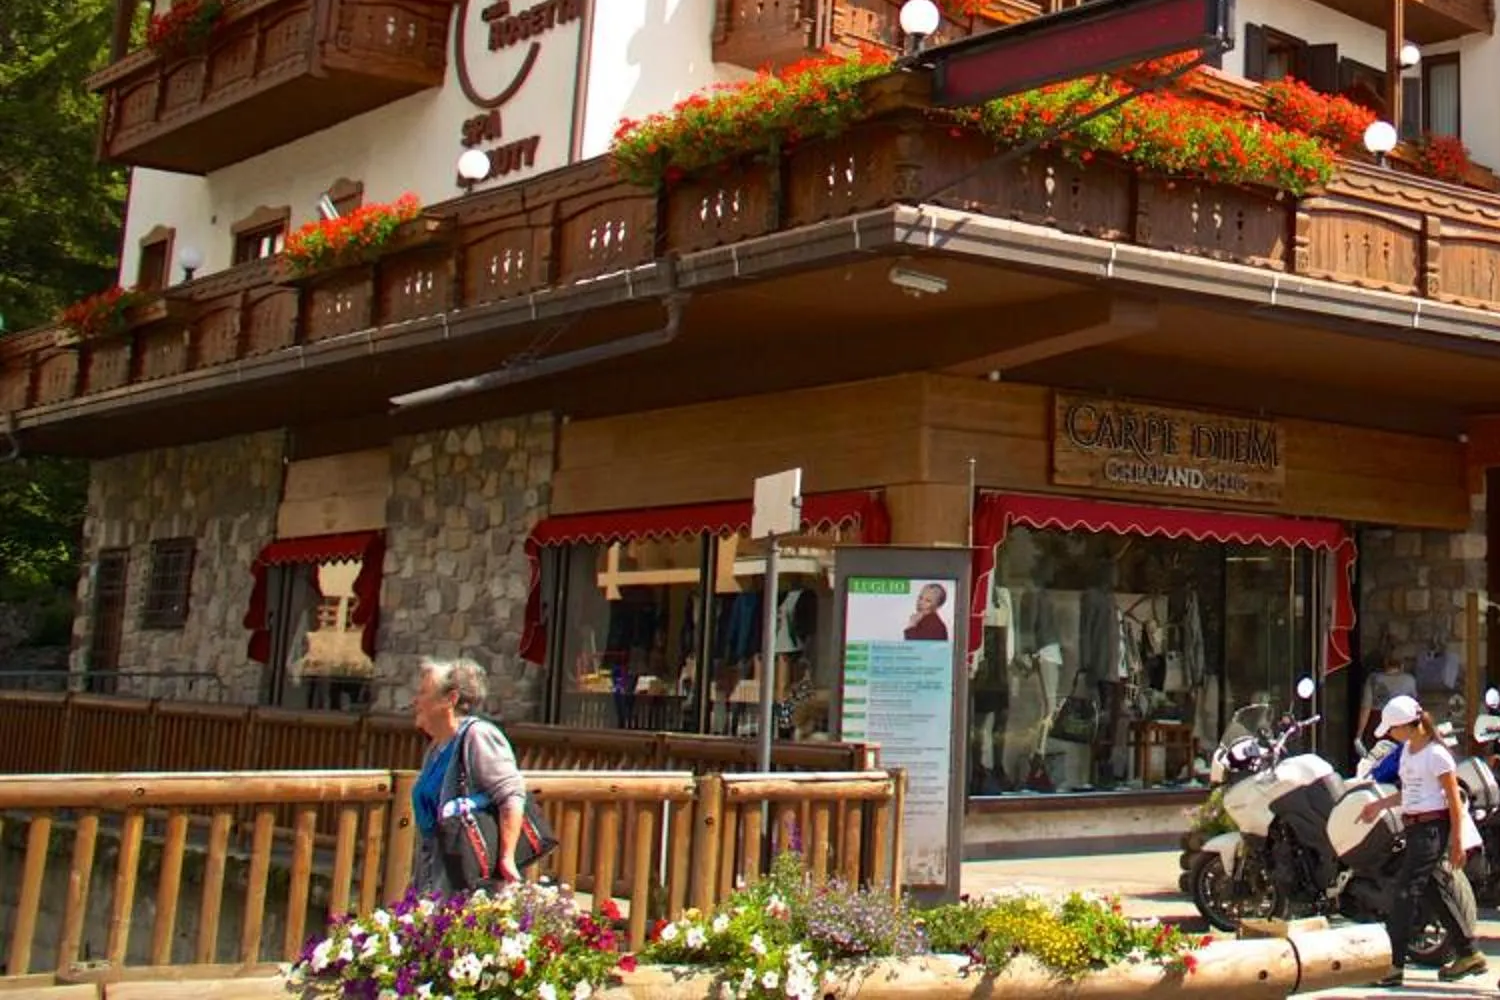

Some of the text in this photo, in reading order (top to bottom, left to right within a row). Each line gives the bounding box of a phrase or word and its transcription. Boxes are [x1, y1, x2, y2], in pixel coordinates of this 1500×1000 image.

[460, 110, 502, 148] SPA
[456, 135, 541, 189] AUTY
[1066, 403, 1282, 469] CARPE DIEM
[853, 580, 906, 593] LUGLIO
